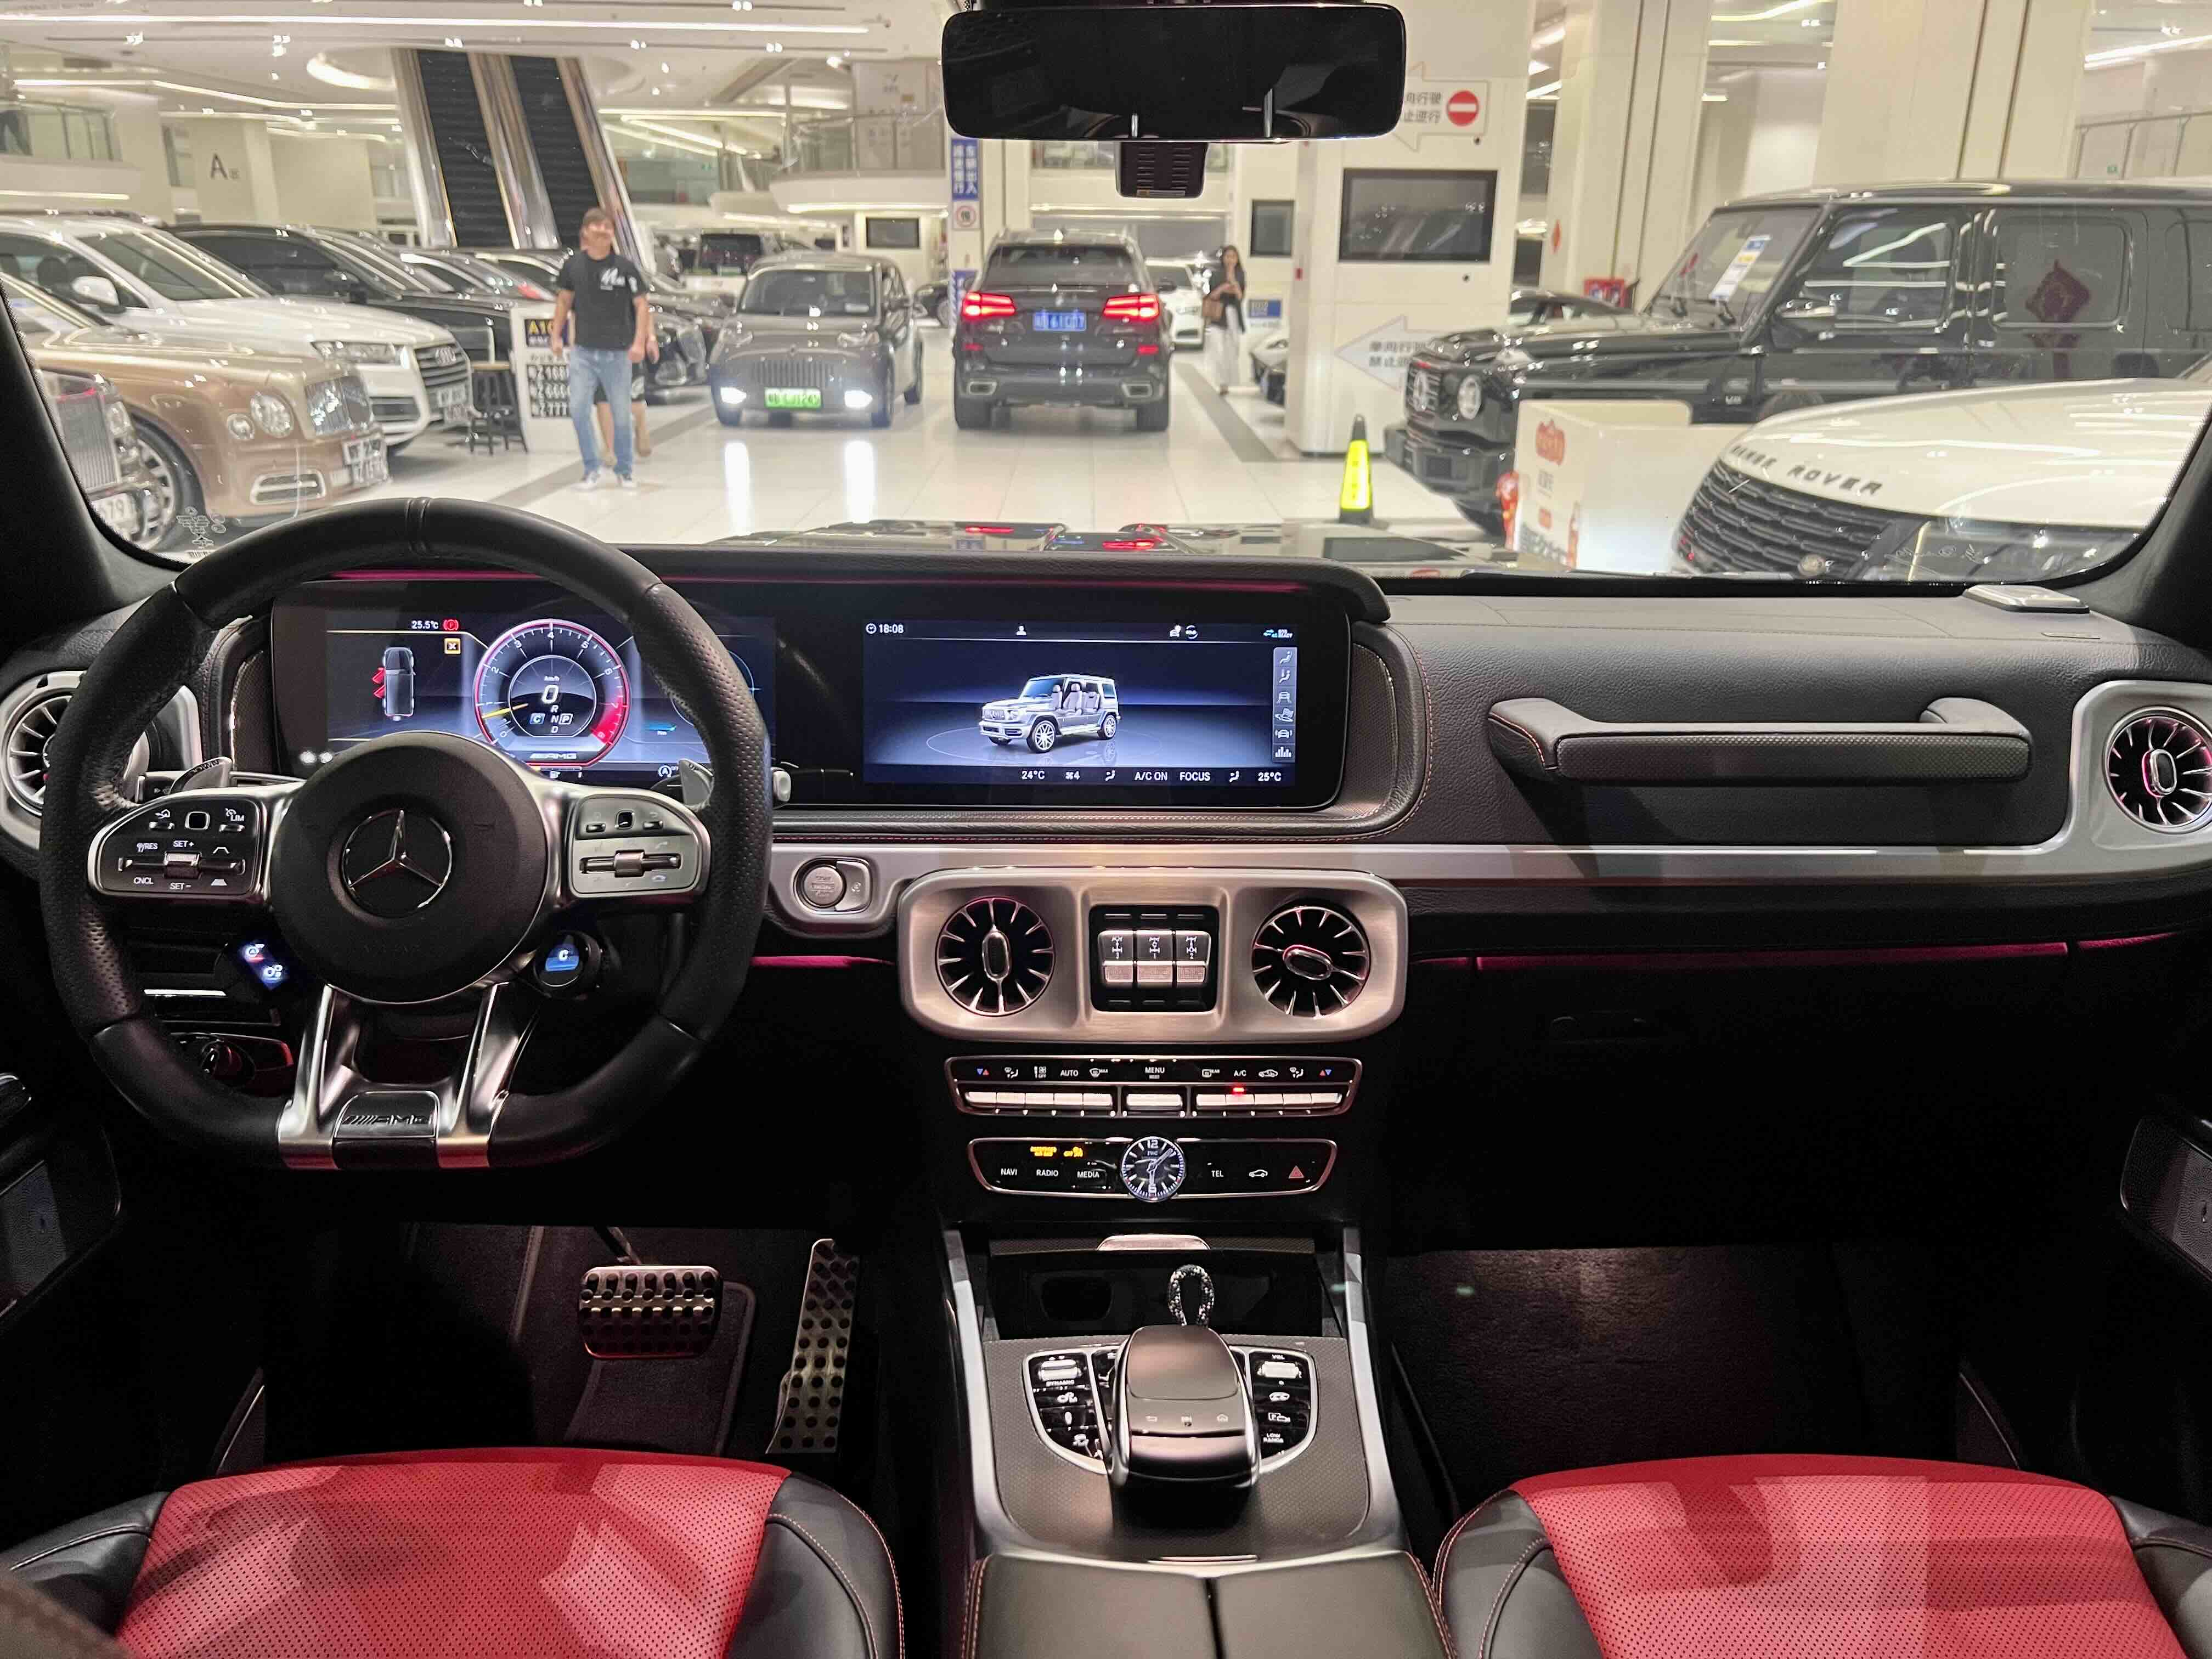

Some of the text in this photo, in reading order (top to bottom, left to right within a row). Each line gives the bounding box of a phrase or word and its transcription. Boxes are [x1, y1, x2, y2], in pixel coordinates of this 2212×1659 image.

[1787, 465, 1882, 494] ROVER
[879, 624, 904, 634] 18:08
[492, 665, 499, 674] 2
[541, 684, 558, 703] 0
[1022, 770, 1080, 780] 24°C 4
[1135, 771, 1282, 781] A/C ON FOCUS 25°C
[1147, 1139, 1159, 1148] 12
